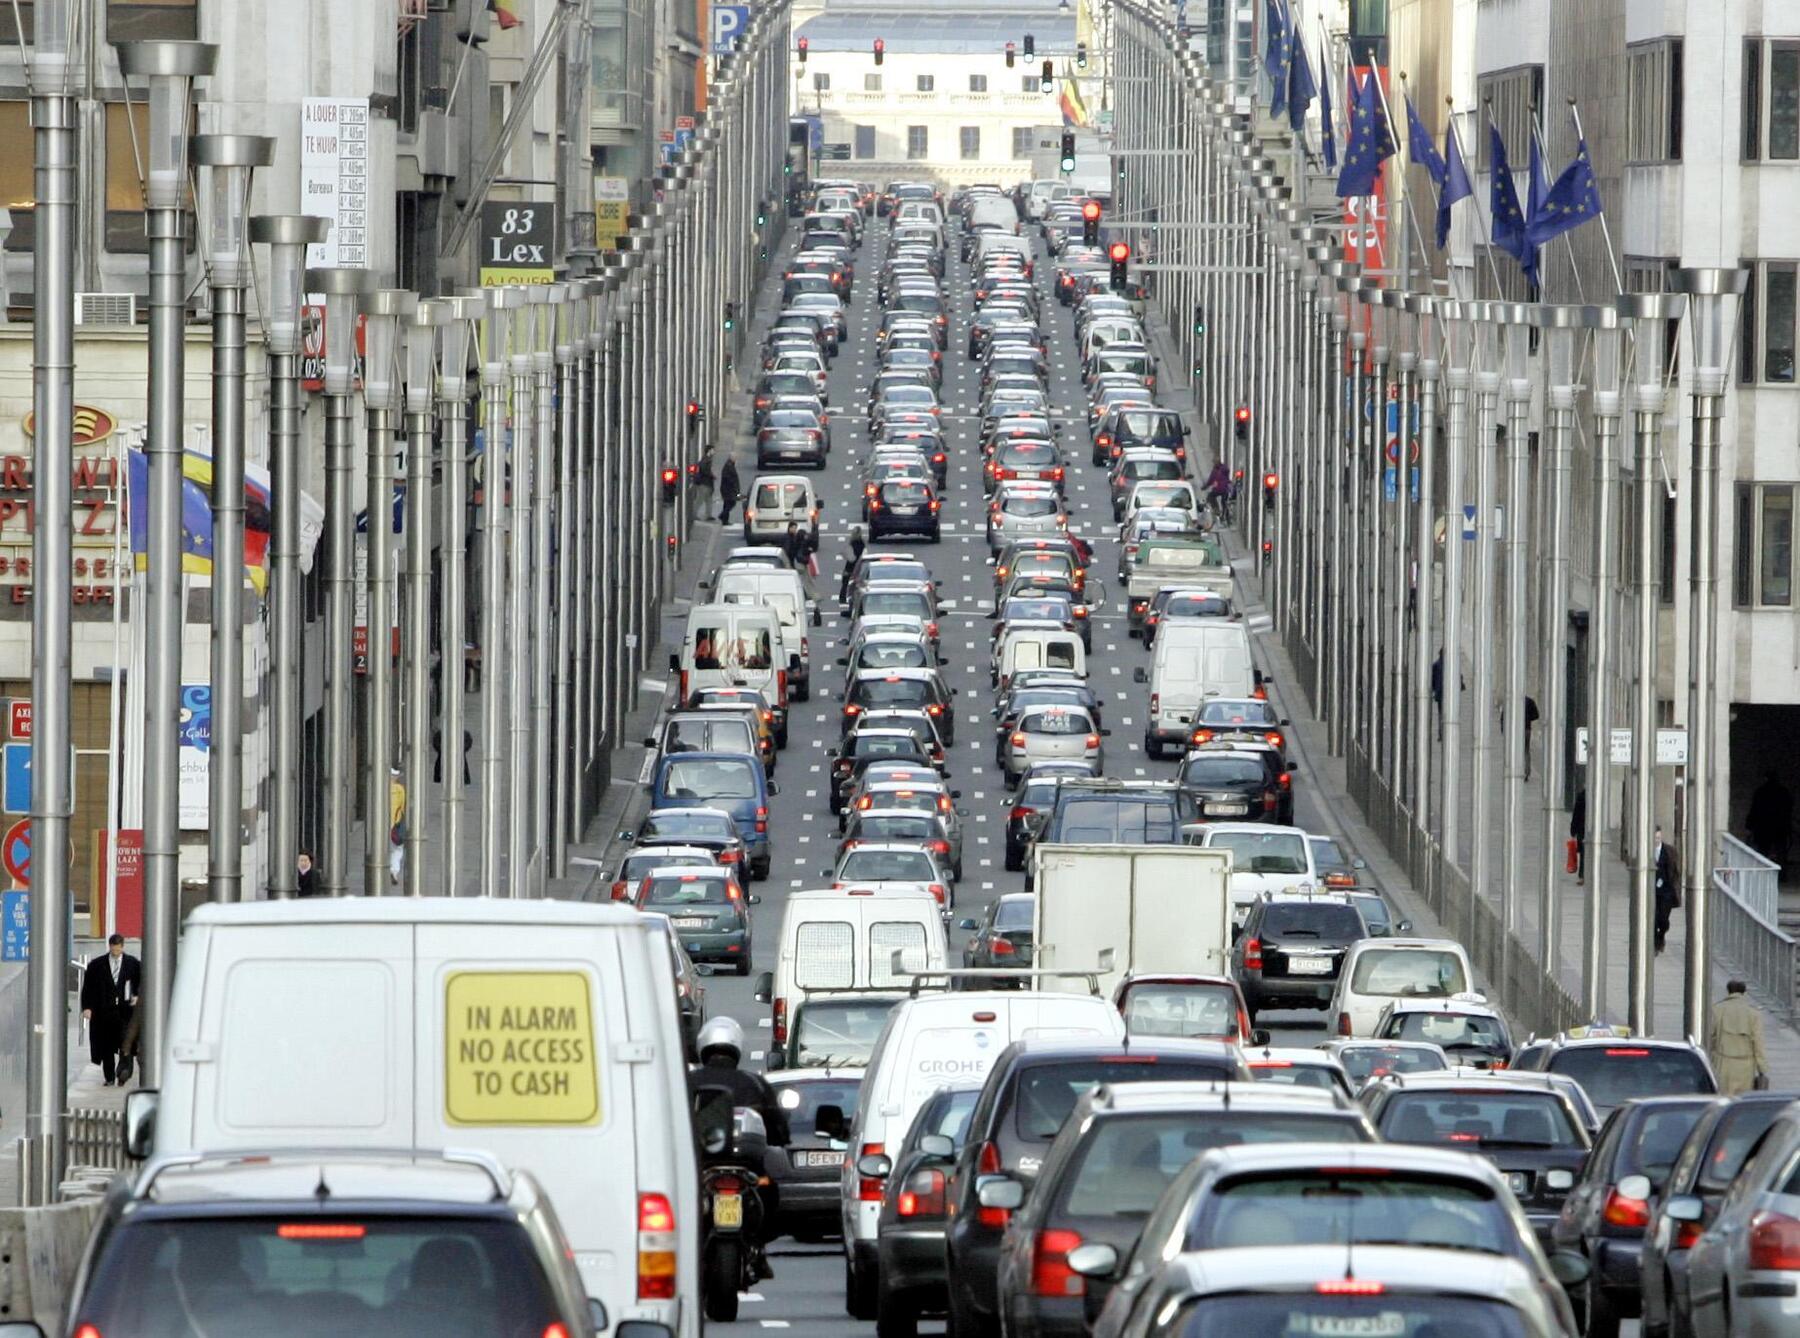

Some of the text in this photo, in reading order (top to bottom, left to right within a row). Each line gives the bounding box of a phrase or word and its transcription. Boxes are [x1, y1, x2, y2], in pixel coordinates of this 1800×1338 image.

[716, 8, 738, 44] P
[306, 105, 338, 122] A LOUER
[306, 136, 338, 153] TE HUUR
[501, 209, 535, 234] 83
[489, 236, 545, 263] Lex
[467, 1006, 577, 1030] IN ALARM
[460, 1038, 584, 1063] NO ACCESS
[919, 1060, 985, 1073] GROHE
[473, 1070, 569, 1095] TO CASH
